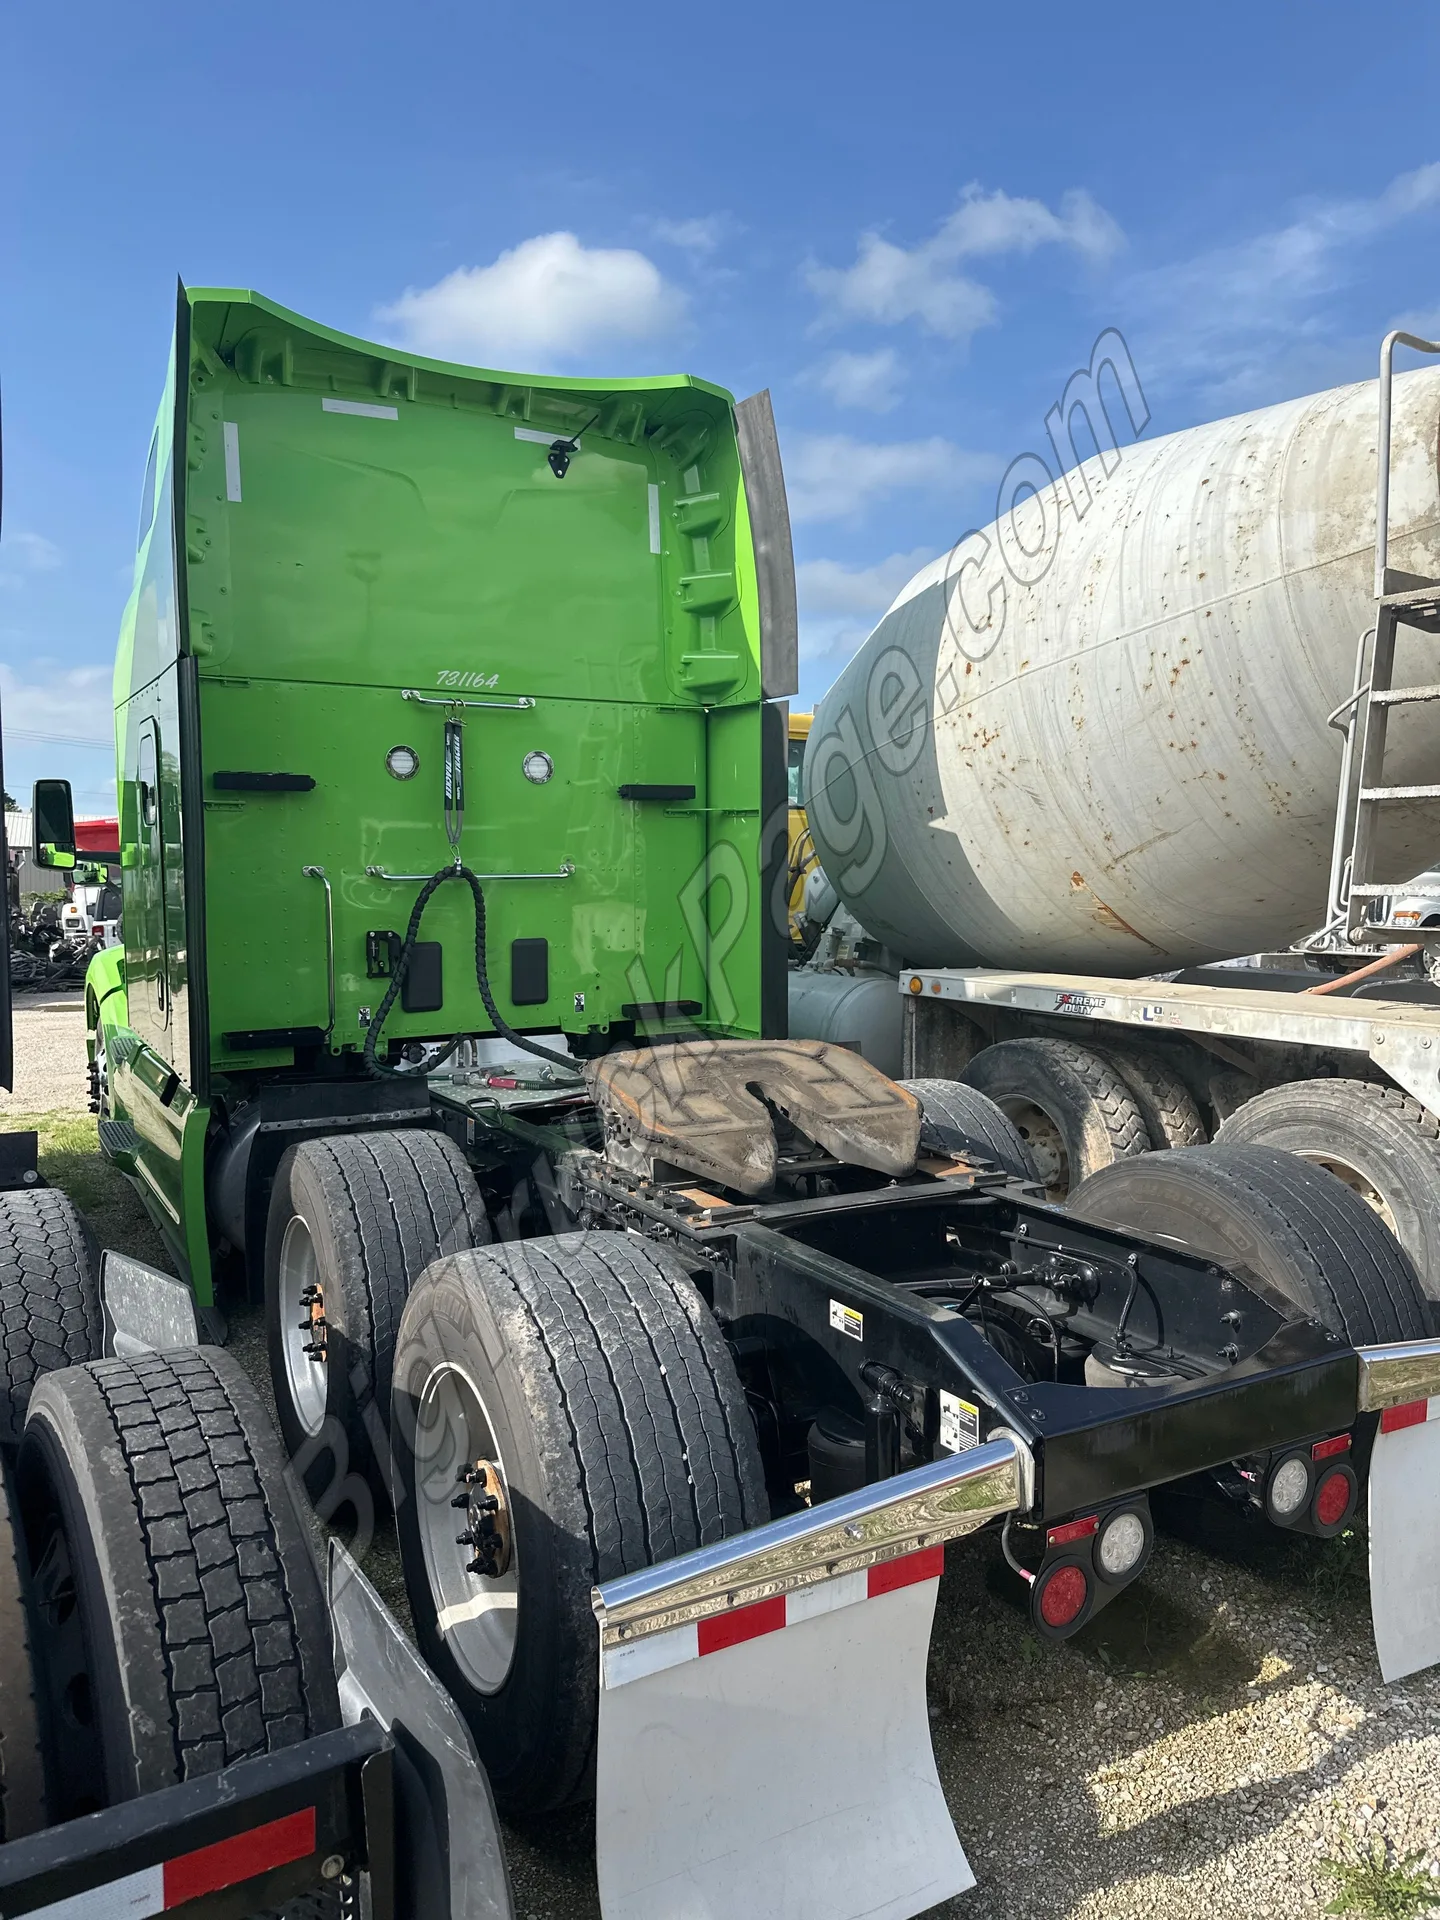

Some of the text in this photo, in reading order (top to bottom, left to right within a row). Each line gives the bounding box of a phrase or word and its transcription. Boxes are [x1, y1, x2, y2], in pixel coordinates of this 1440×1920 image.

[436, 670, 500, 689] 731164
[1054, 993, 1106, 1009] EXTREME
[1063, 1003, 1094, 1015] DUTY
